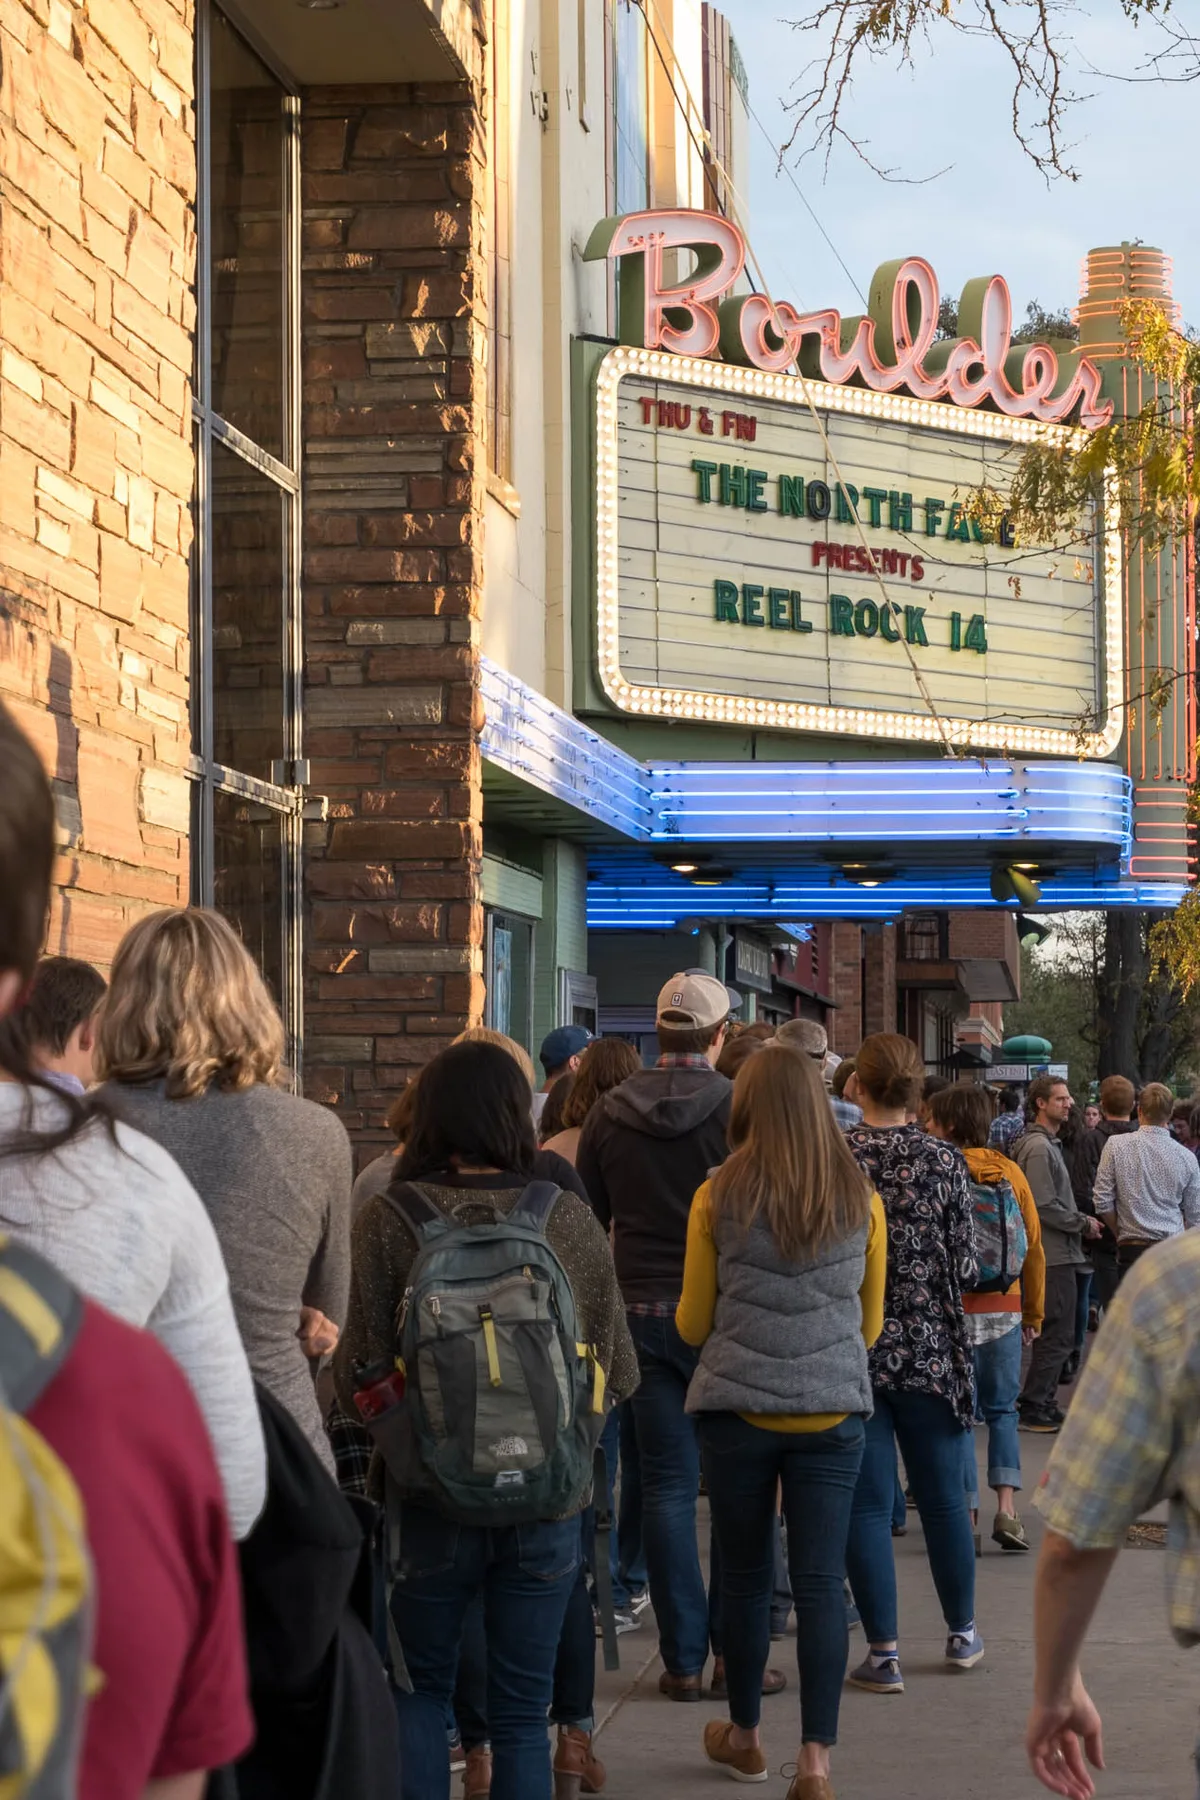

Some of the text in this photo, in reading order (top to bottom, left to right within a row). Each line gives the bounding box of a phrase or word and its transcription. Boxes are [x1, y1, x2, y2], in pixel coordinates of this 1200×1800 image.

[602, 208, 1114, 431] Boulder
[639, 396, 757, 442] THU & FRI
[692, 459, 1018, 548] THE NORTH FAE
[811, 540, 925, 581] PRESENTS
[714, 579, 988, 654] REEL ROCK 14
